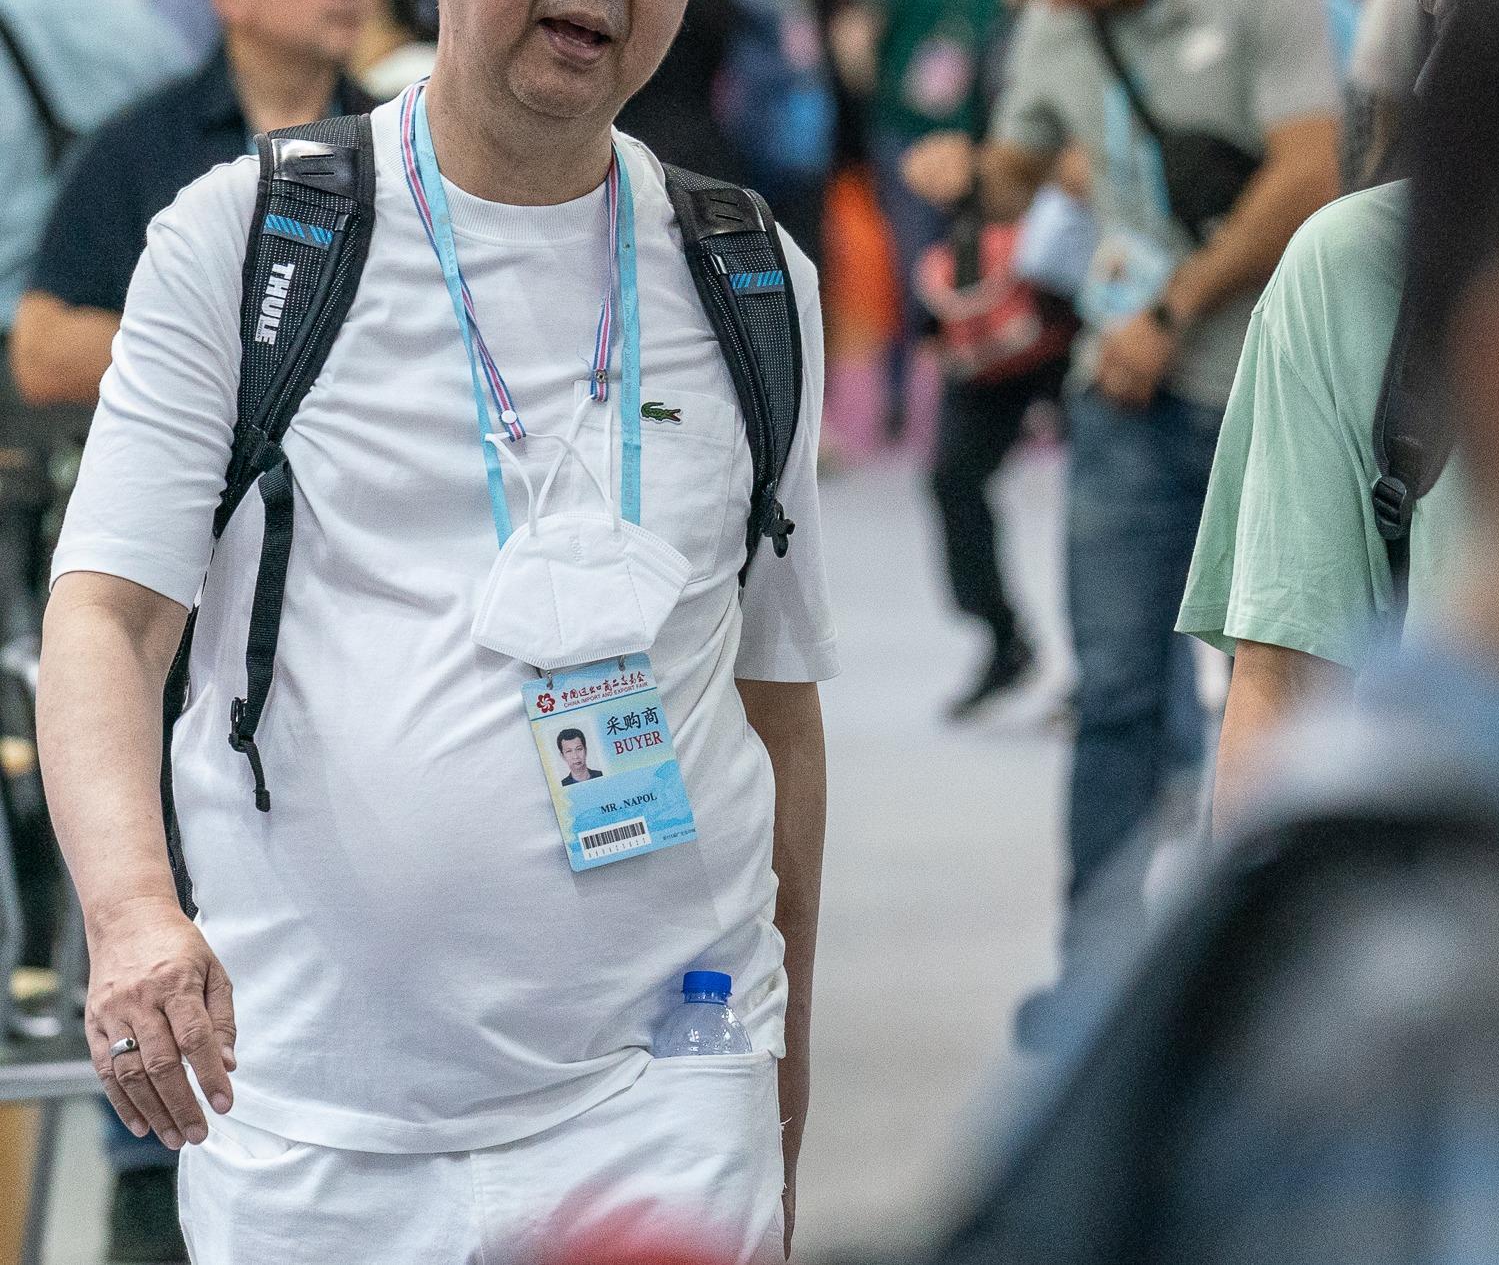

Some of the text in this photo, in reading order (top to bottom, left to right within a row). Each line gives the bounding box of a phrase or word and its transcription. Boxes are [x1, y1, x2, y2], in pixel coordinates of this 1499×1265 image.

[254, 263, 295, 345] THULE
[564, 700, 580, 708] CHINA
[581, 694, 600, 703] IMPORT
[614, 685, 635, 695] EXPORT
[606, 707, 658, 735] 采购商
[613, 731, 663, 755] BUYER
[623, 793, 658, 808] NAPOL
